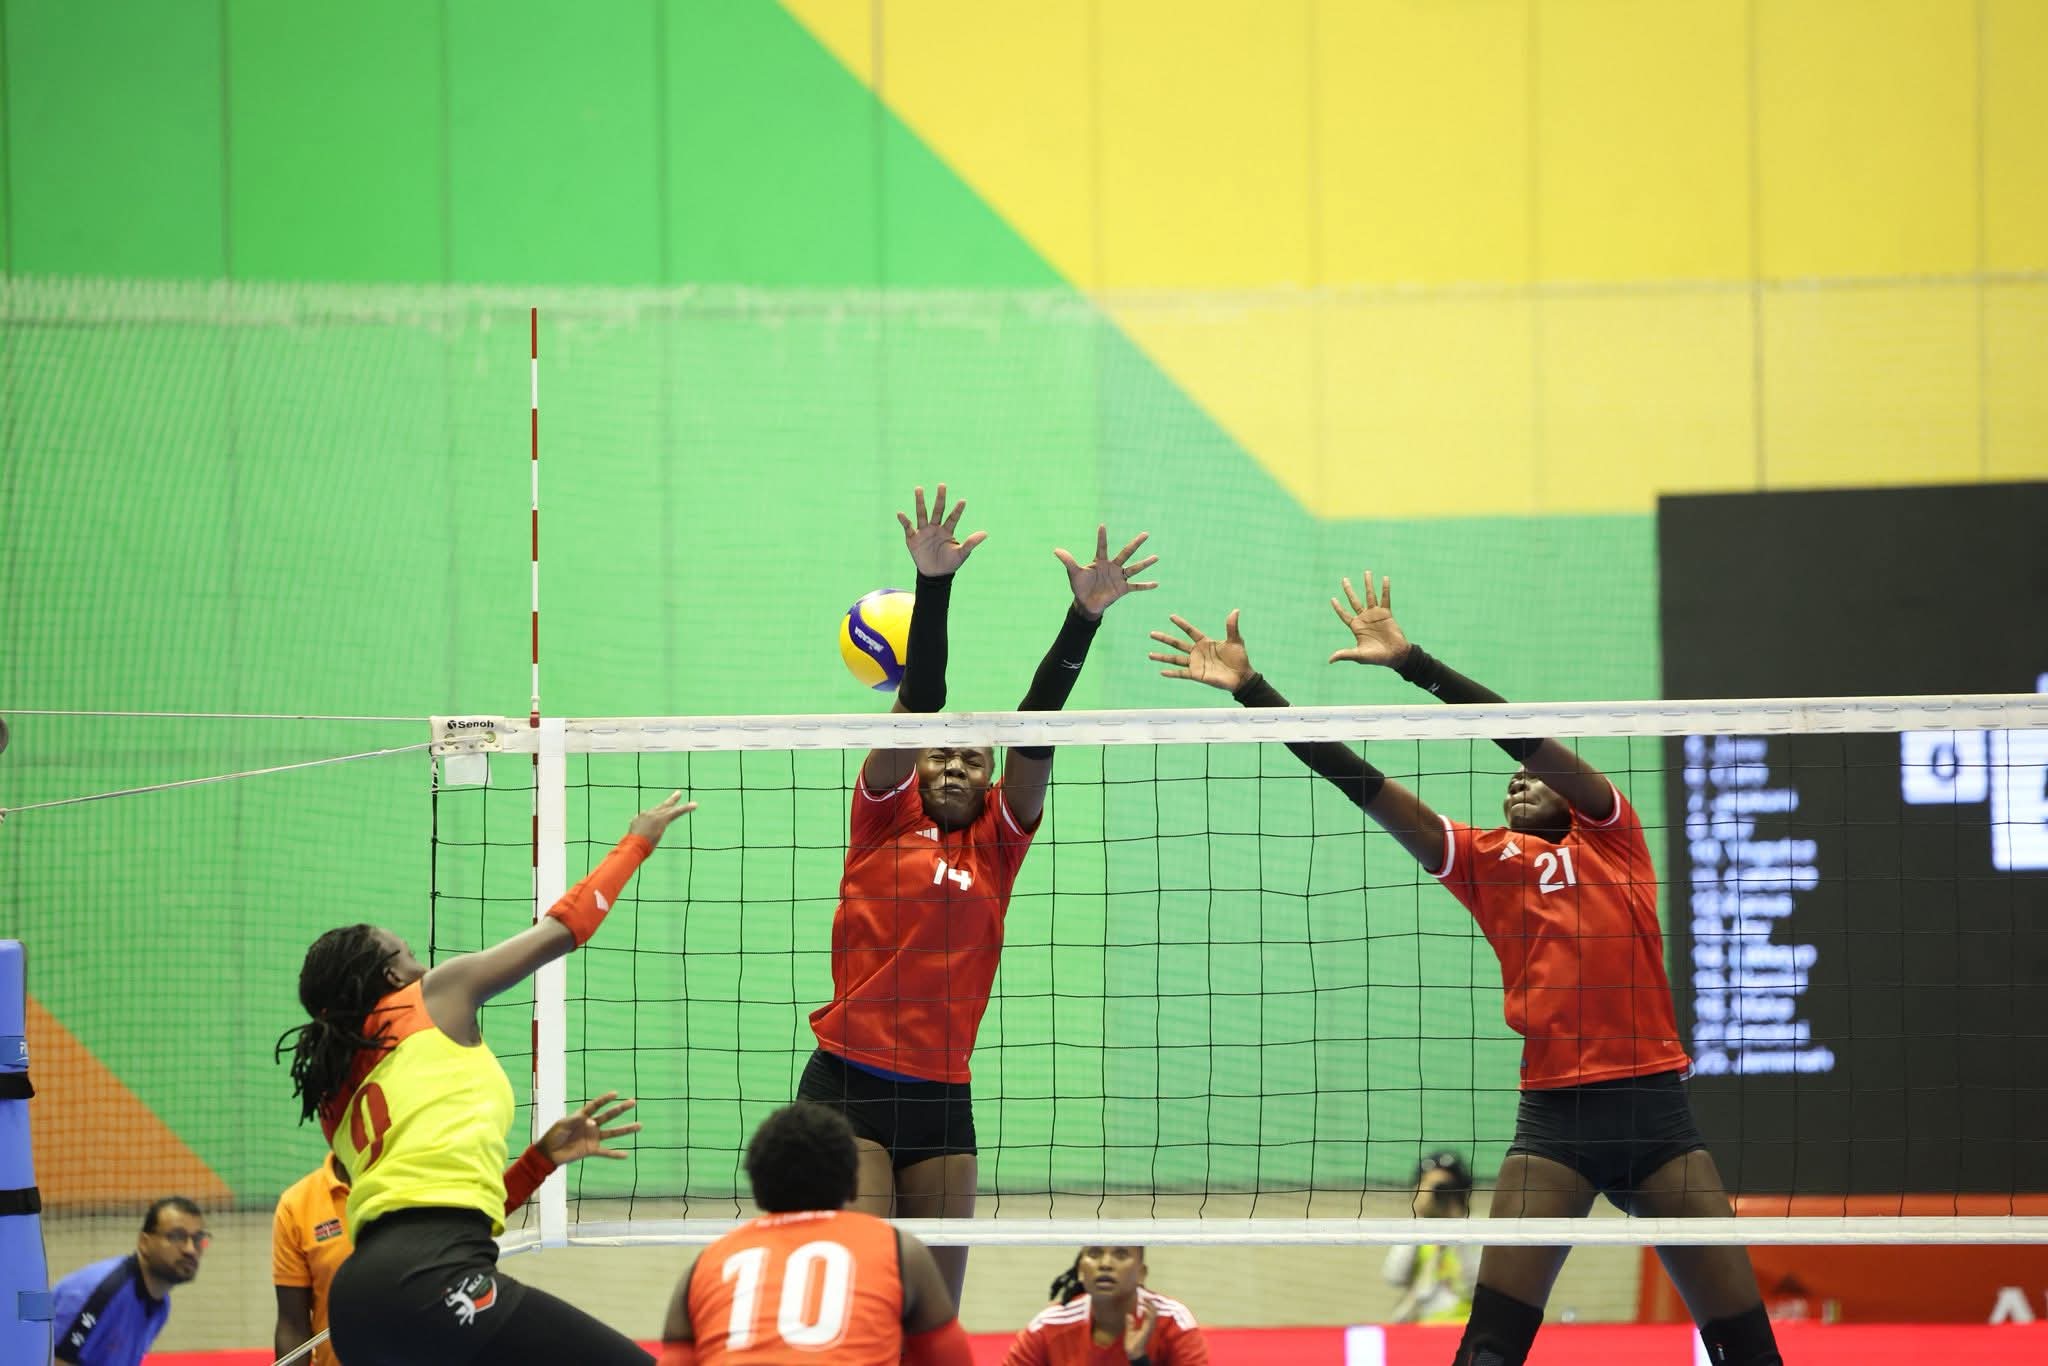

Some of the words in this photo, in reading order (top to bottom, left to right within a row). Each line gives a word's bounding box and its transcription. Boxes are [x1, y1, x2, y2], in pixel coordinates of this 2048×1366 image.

[457, 719, 495, 729] Senoh
[933, 857, 972, 892] 14
[1533, 846, 1577, 895] 21
[721, 1240, 855, 1352] 10
